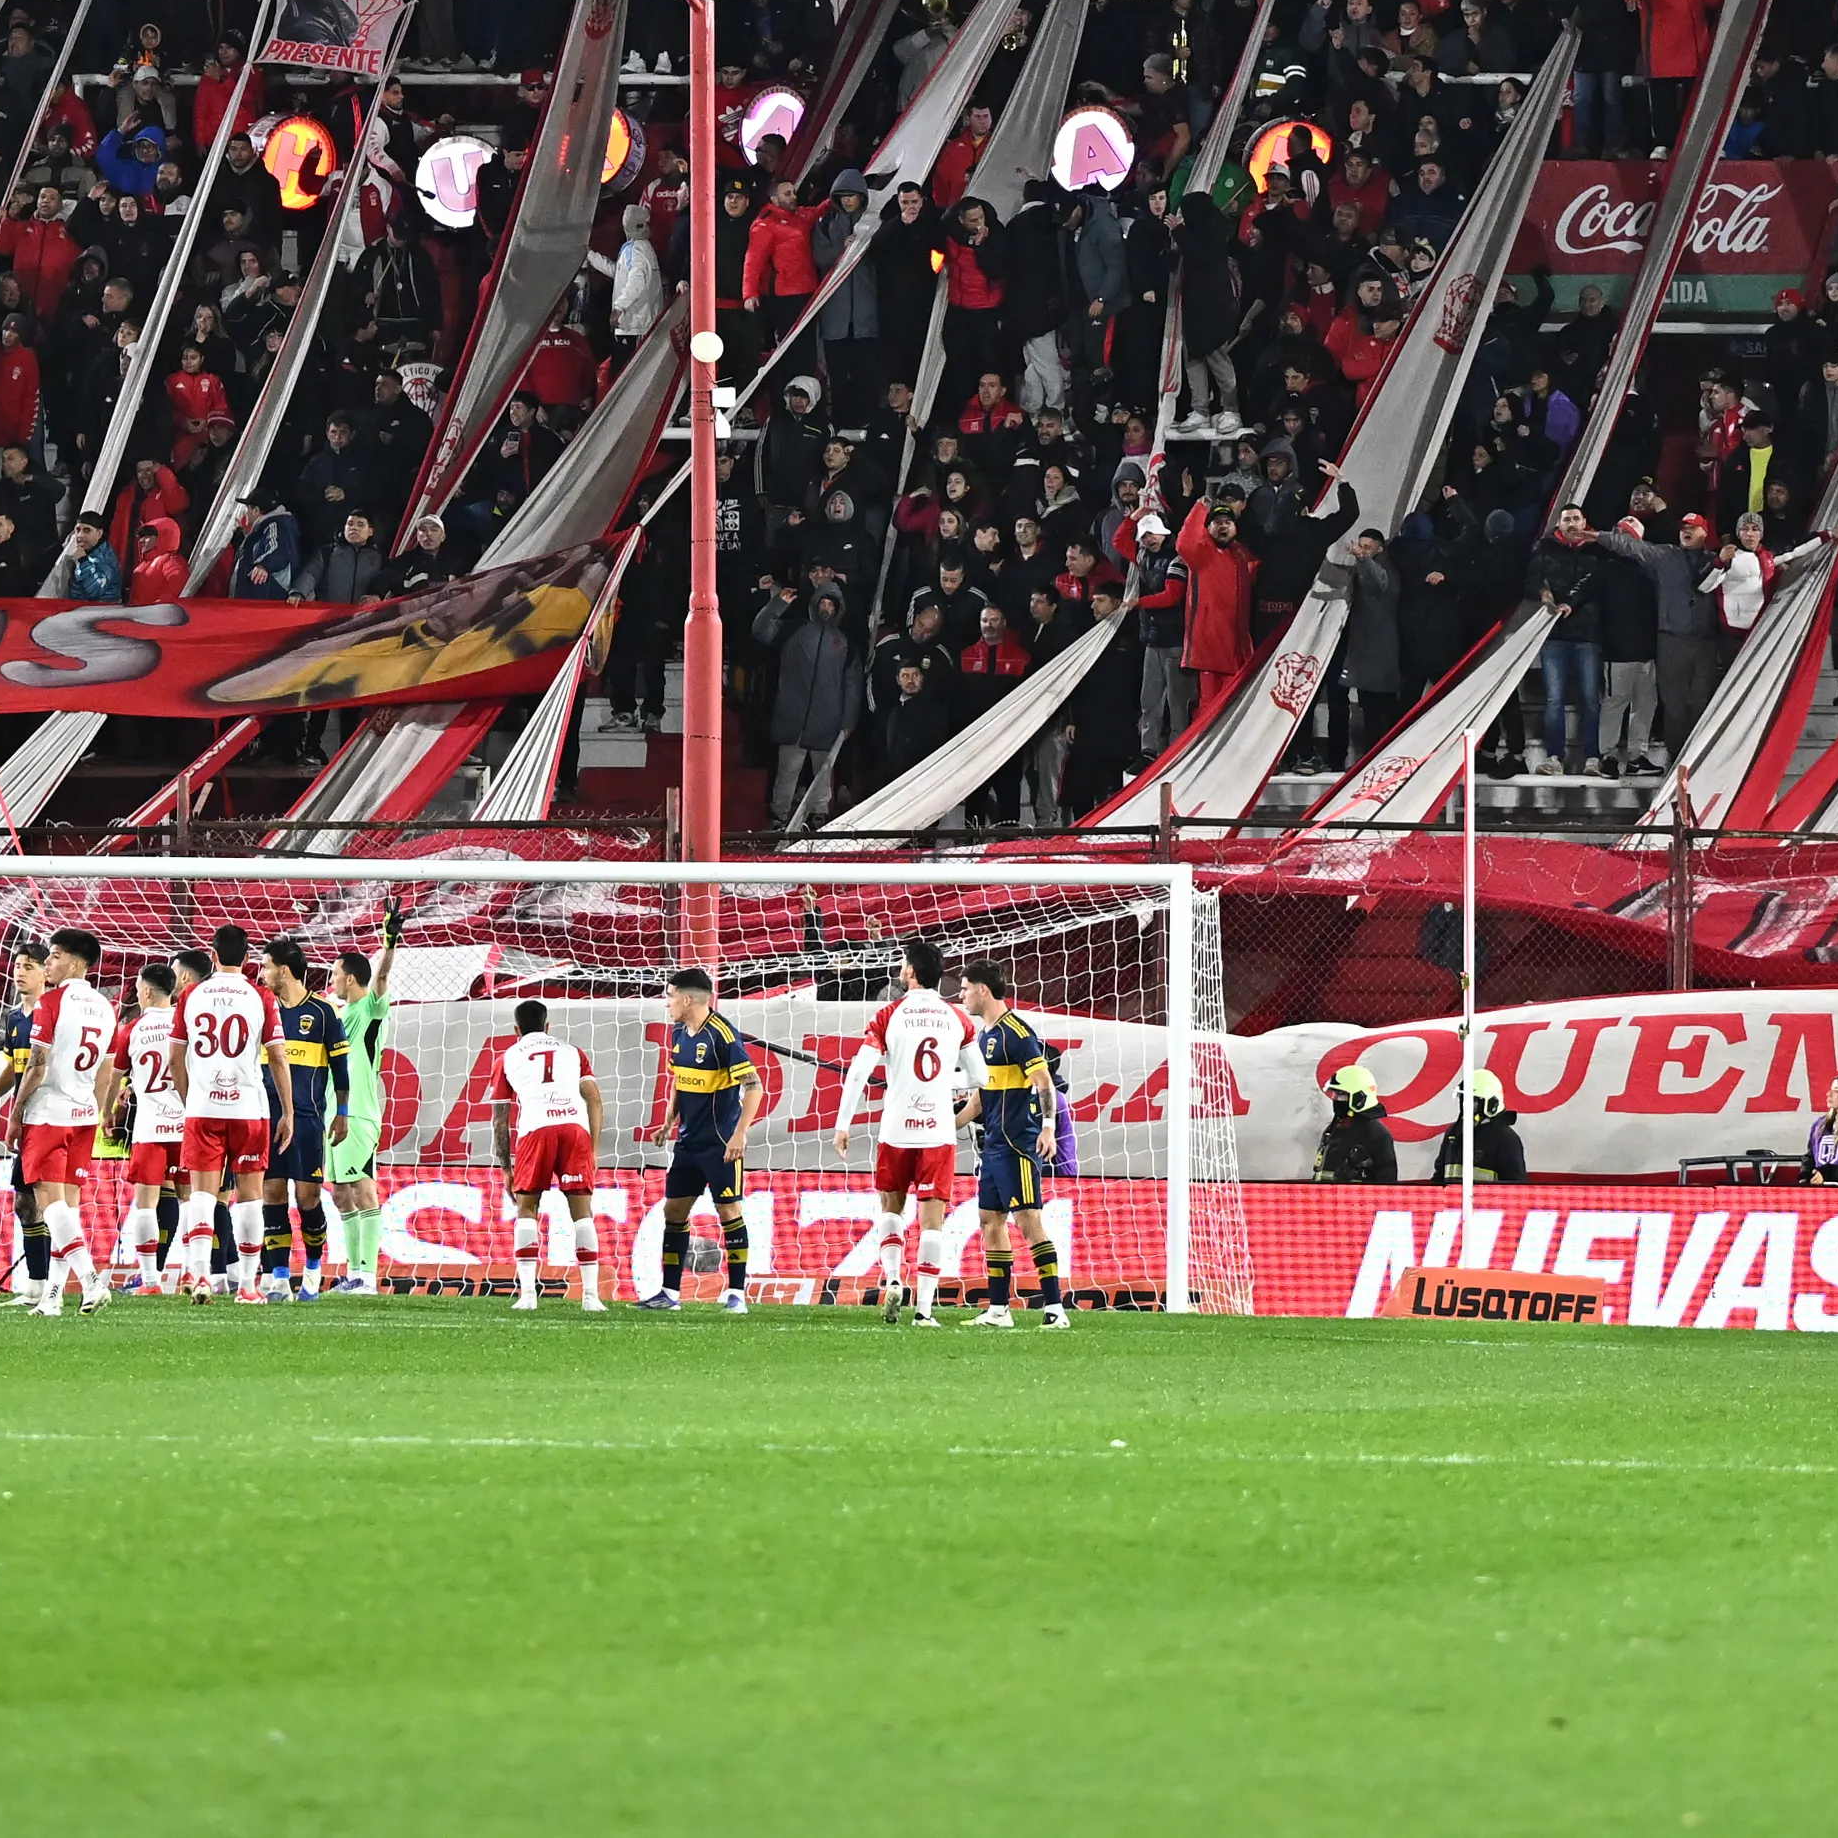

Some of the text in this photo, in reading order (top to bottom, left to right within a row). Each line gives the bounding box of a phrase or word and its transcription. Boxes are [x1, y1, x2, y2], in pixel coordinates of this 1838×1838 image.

[263, 38, 382, 76] PRESENTE
[1068, 123, 1126, 187] A
[203, 987, 248, 997] Casablanca
[212, 997, 234, 1008] PAZ
[902, 1007, 948, 1016] Casablanca
[904, 1019, 951, 1031] PEREYRA
[74, 1026, 103, 1072] 5
[194, 1013, 249, 1059] 30
[528, 1049, 558, 1085] 7
[913, 1036, 942, 1083] 6
